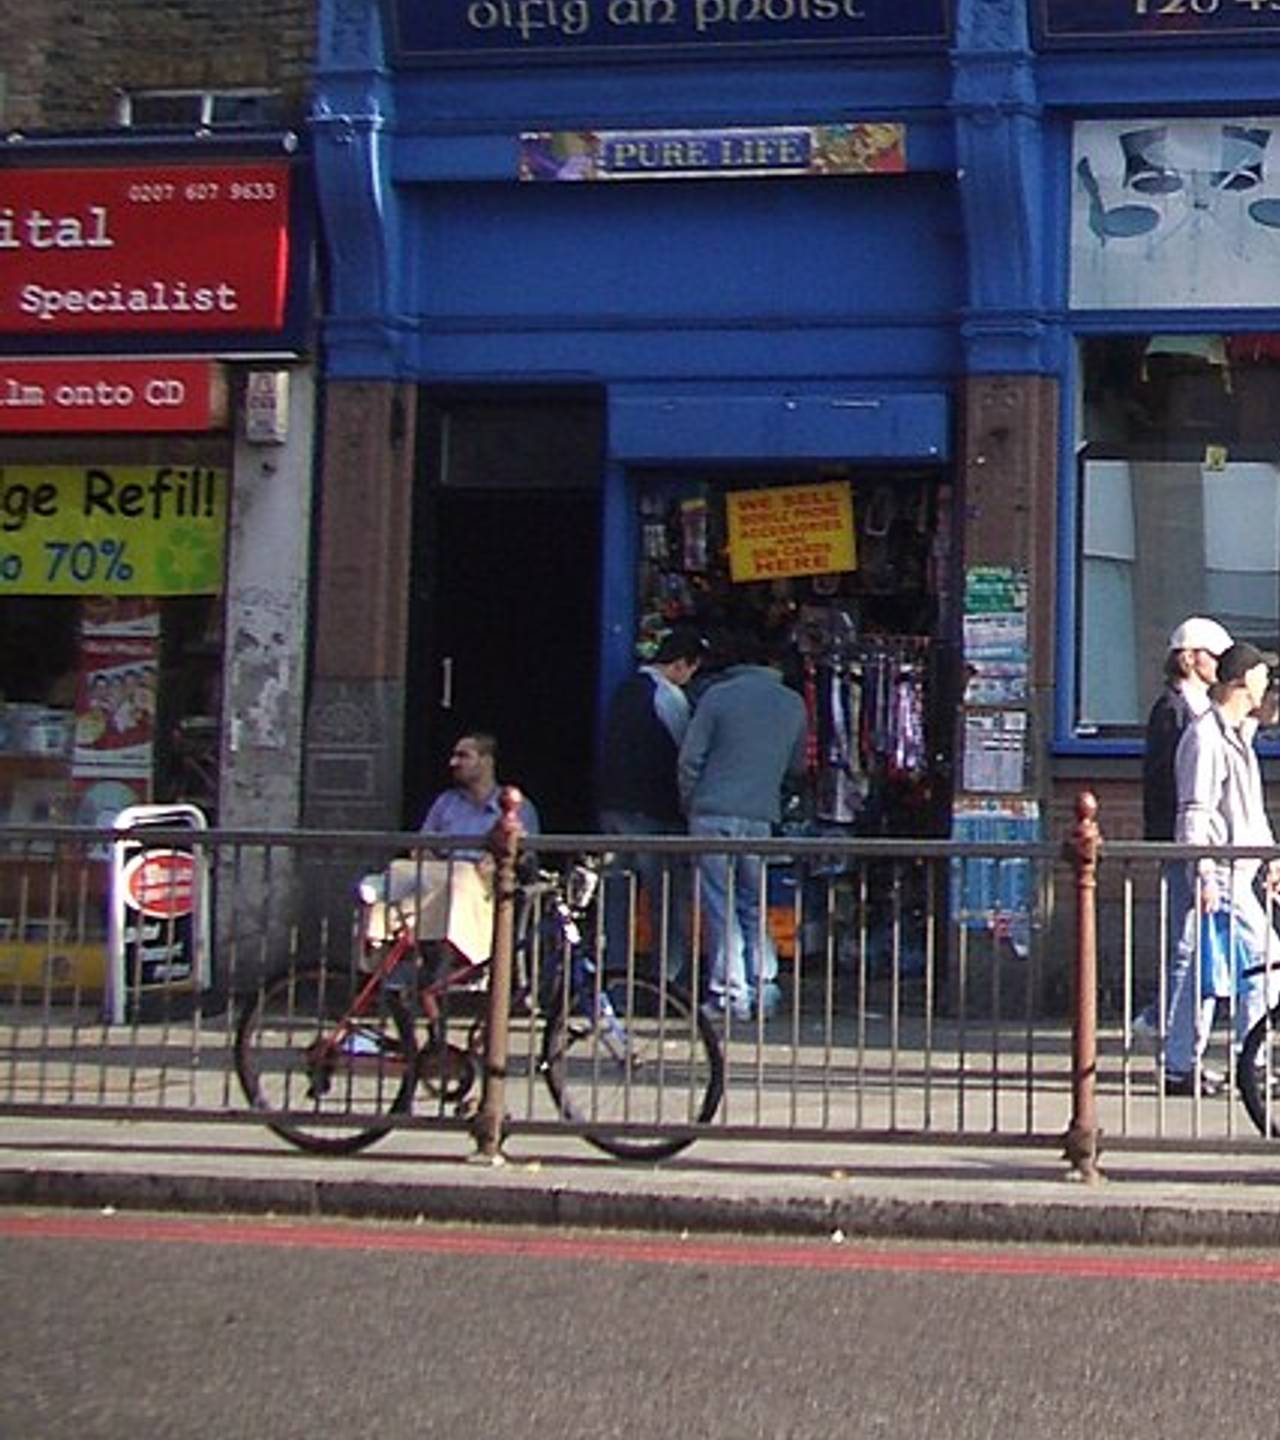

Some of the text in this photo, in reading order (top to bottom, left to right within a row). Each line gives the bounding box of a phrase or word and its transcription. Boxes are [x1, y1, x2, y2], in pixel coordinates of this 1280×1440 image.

[614, 137, 802, 168] PURE LIFE
[20, 282, 238, 320] Specialist
[55, 381, 134, 406] onto
[145, 379, 186, 405] CD
[83, 467, 216, 521] Refill!
[44, 538, 134, 582] 70%
